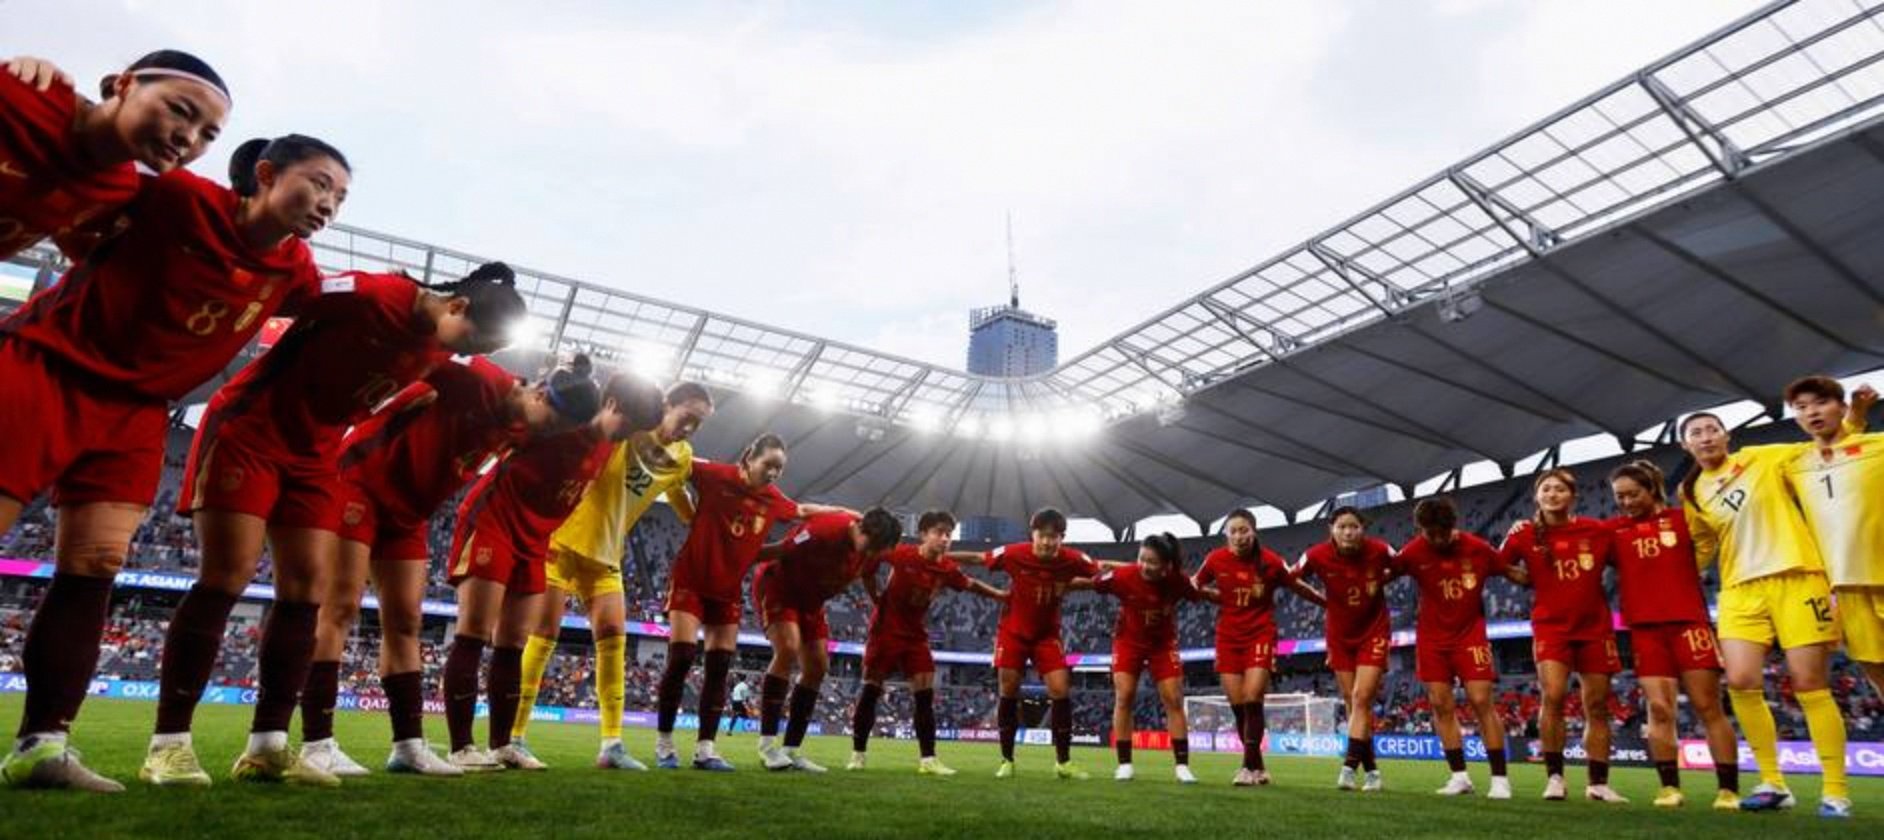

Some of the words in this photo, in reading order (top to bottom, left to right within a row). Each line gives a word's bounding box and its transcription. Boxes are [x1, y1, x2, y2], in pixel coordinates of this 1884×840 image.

[186, 300, 228, 335] 8
[1819, 474, 1834, 499] 1
[1721, 488, 1746, 512] 12
[730, 513, 745, 537] 6
[1632, 537, 1661, 559] 18
[1554, 559, 1580, 580] 13
[139, 574, 188, 590] ASIAN
[1438, 579, 1464, 600] 16
[1234, 587, 1252, 607] 17
[1348, 586, 1361, 606] 2
[1805, 597, 1833, 623] 12
[1372, 637, 1386, 654] 2
[1682, 628, 1713, 652] 18
[1377, 739, 1434, 757] CREDIT
